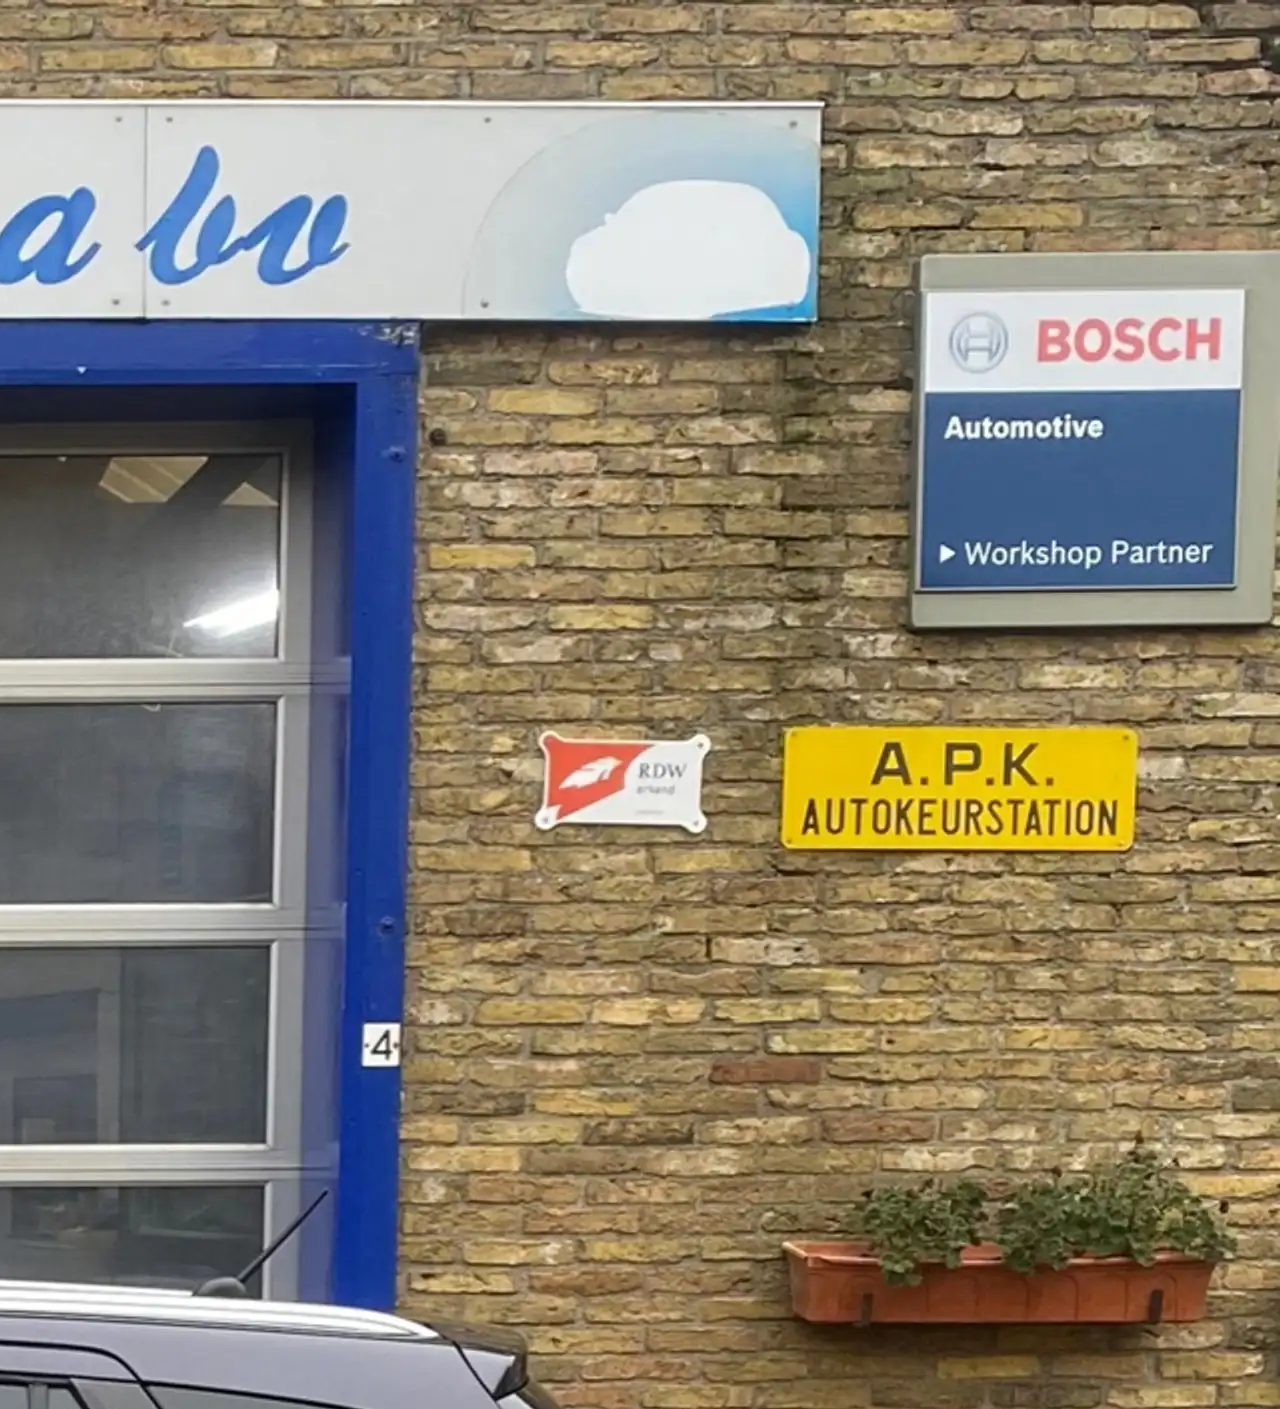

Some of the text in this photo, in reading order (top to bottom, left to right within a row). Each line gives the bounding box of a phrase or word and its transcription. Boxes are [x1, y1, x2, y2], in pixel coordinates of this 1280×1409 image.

[137, 145, 350, 286] bv
[1036, 317, 1222, 363] BOSCH
[944, 414, 1105, 440] Automotive
[965, 540, 1213, 570] Workshop Partner
[638, 763, 687, 779] RDW
[871, 741, 1056, 786] A.P.K.
[801, 799, 1118, 836] AUTOKEURSTATION
[370, 1028, 393, 1061] 4
